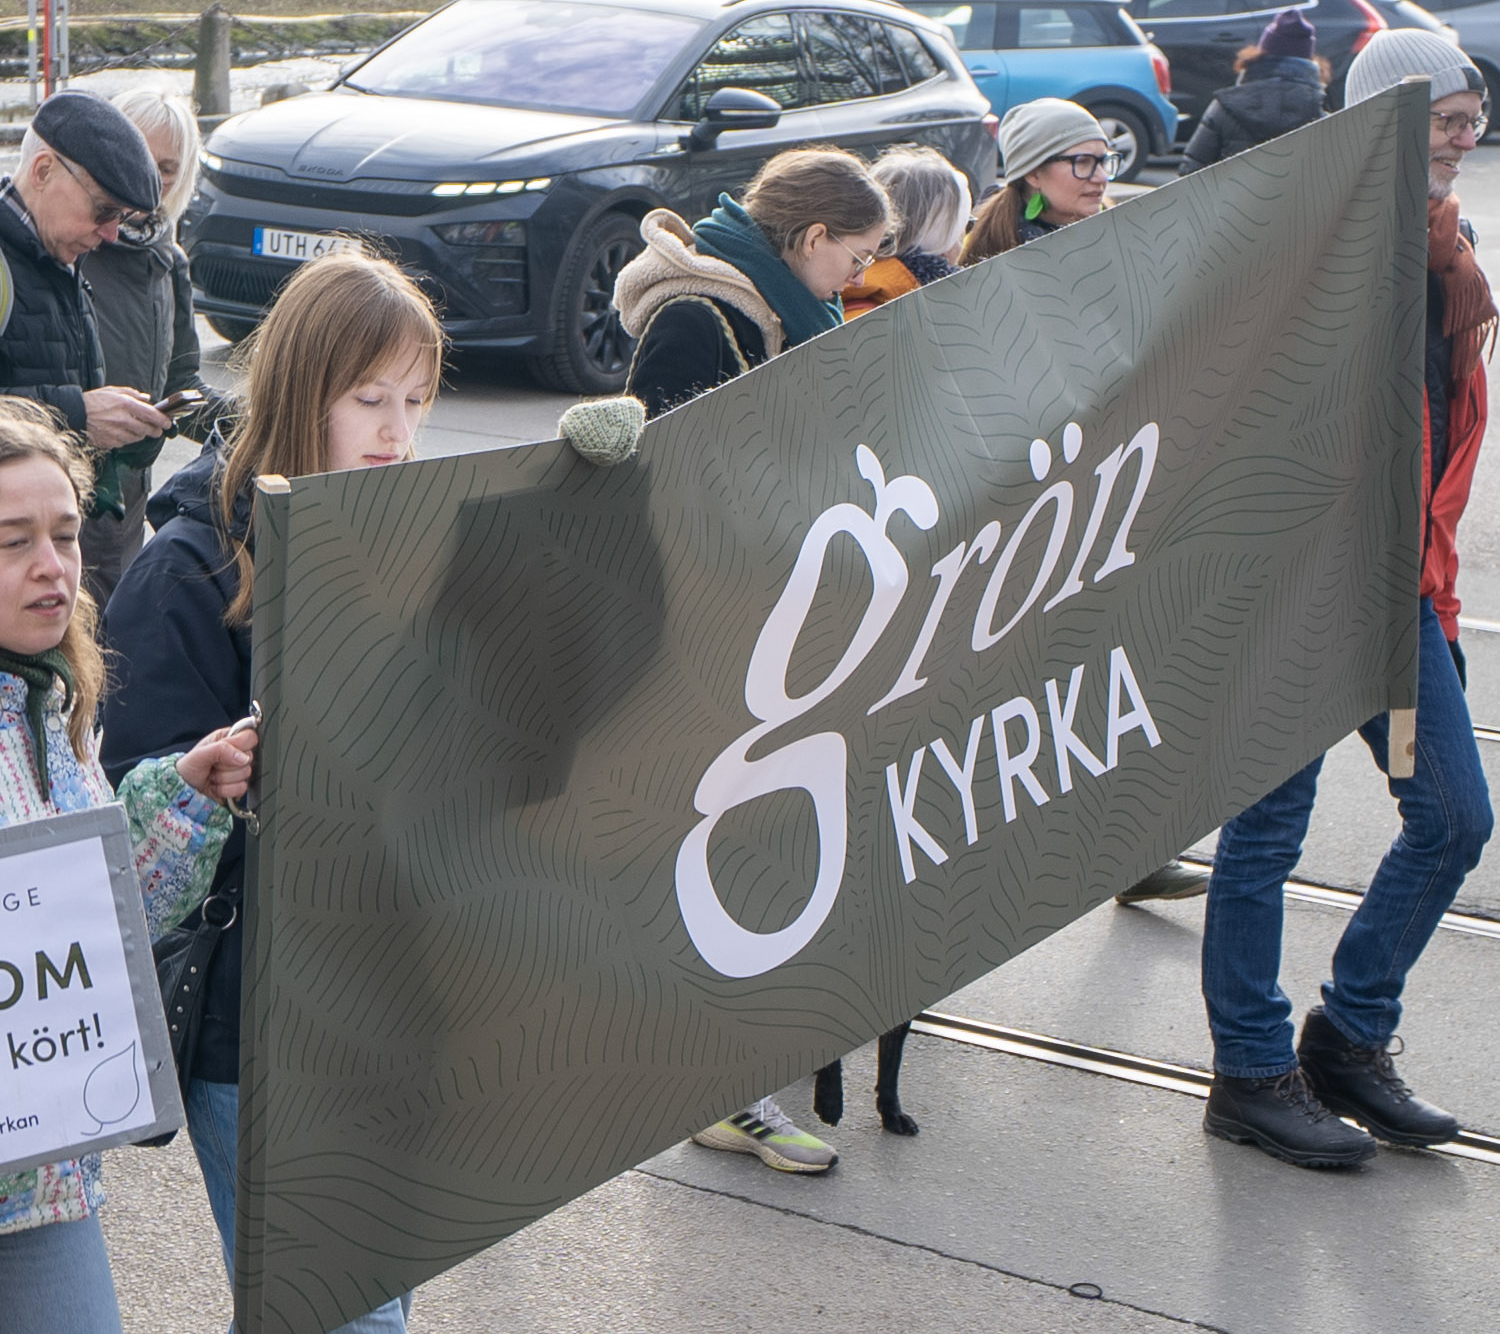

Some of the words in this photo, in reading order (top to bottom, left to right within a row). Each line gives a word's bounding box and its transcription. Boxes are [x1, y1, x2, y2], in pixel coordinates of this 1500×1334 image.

[270, 232, 307, 257] UTH
[675, 422, 1160, 979] grön
[885, 646, 1162, 885] KYRKA
[6, 1013, 105, 1070] kört!
